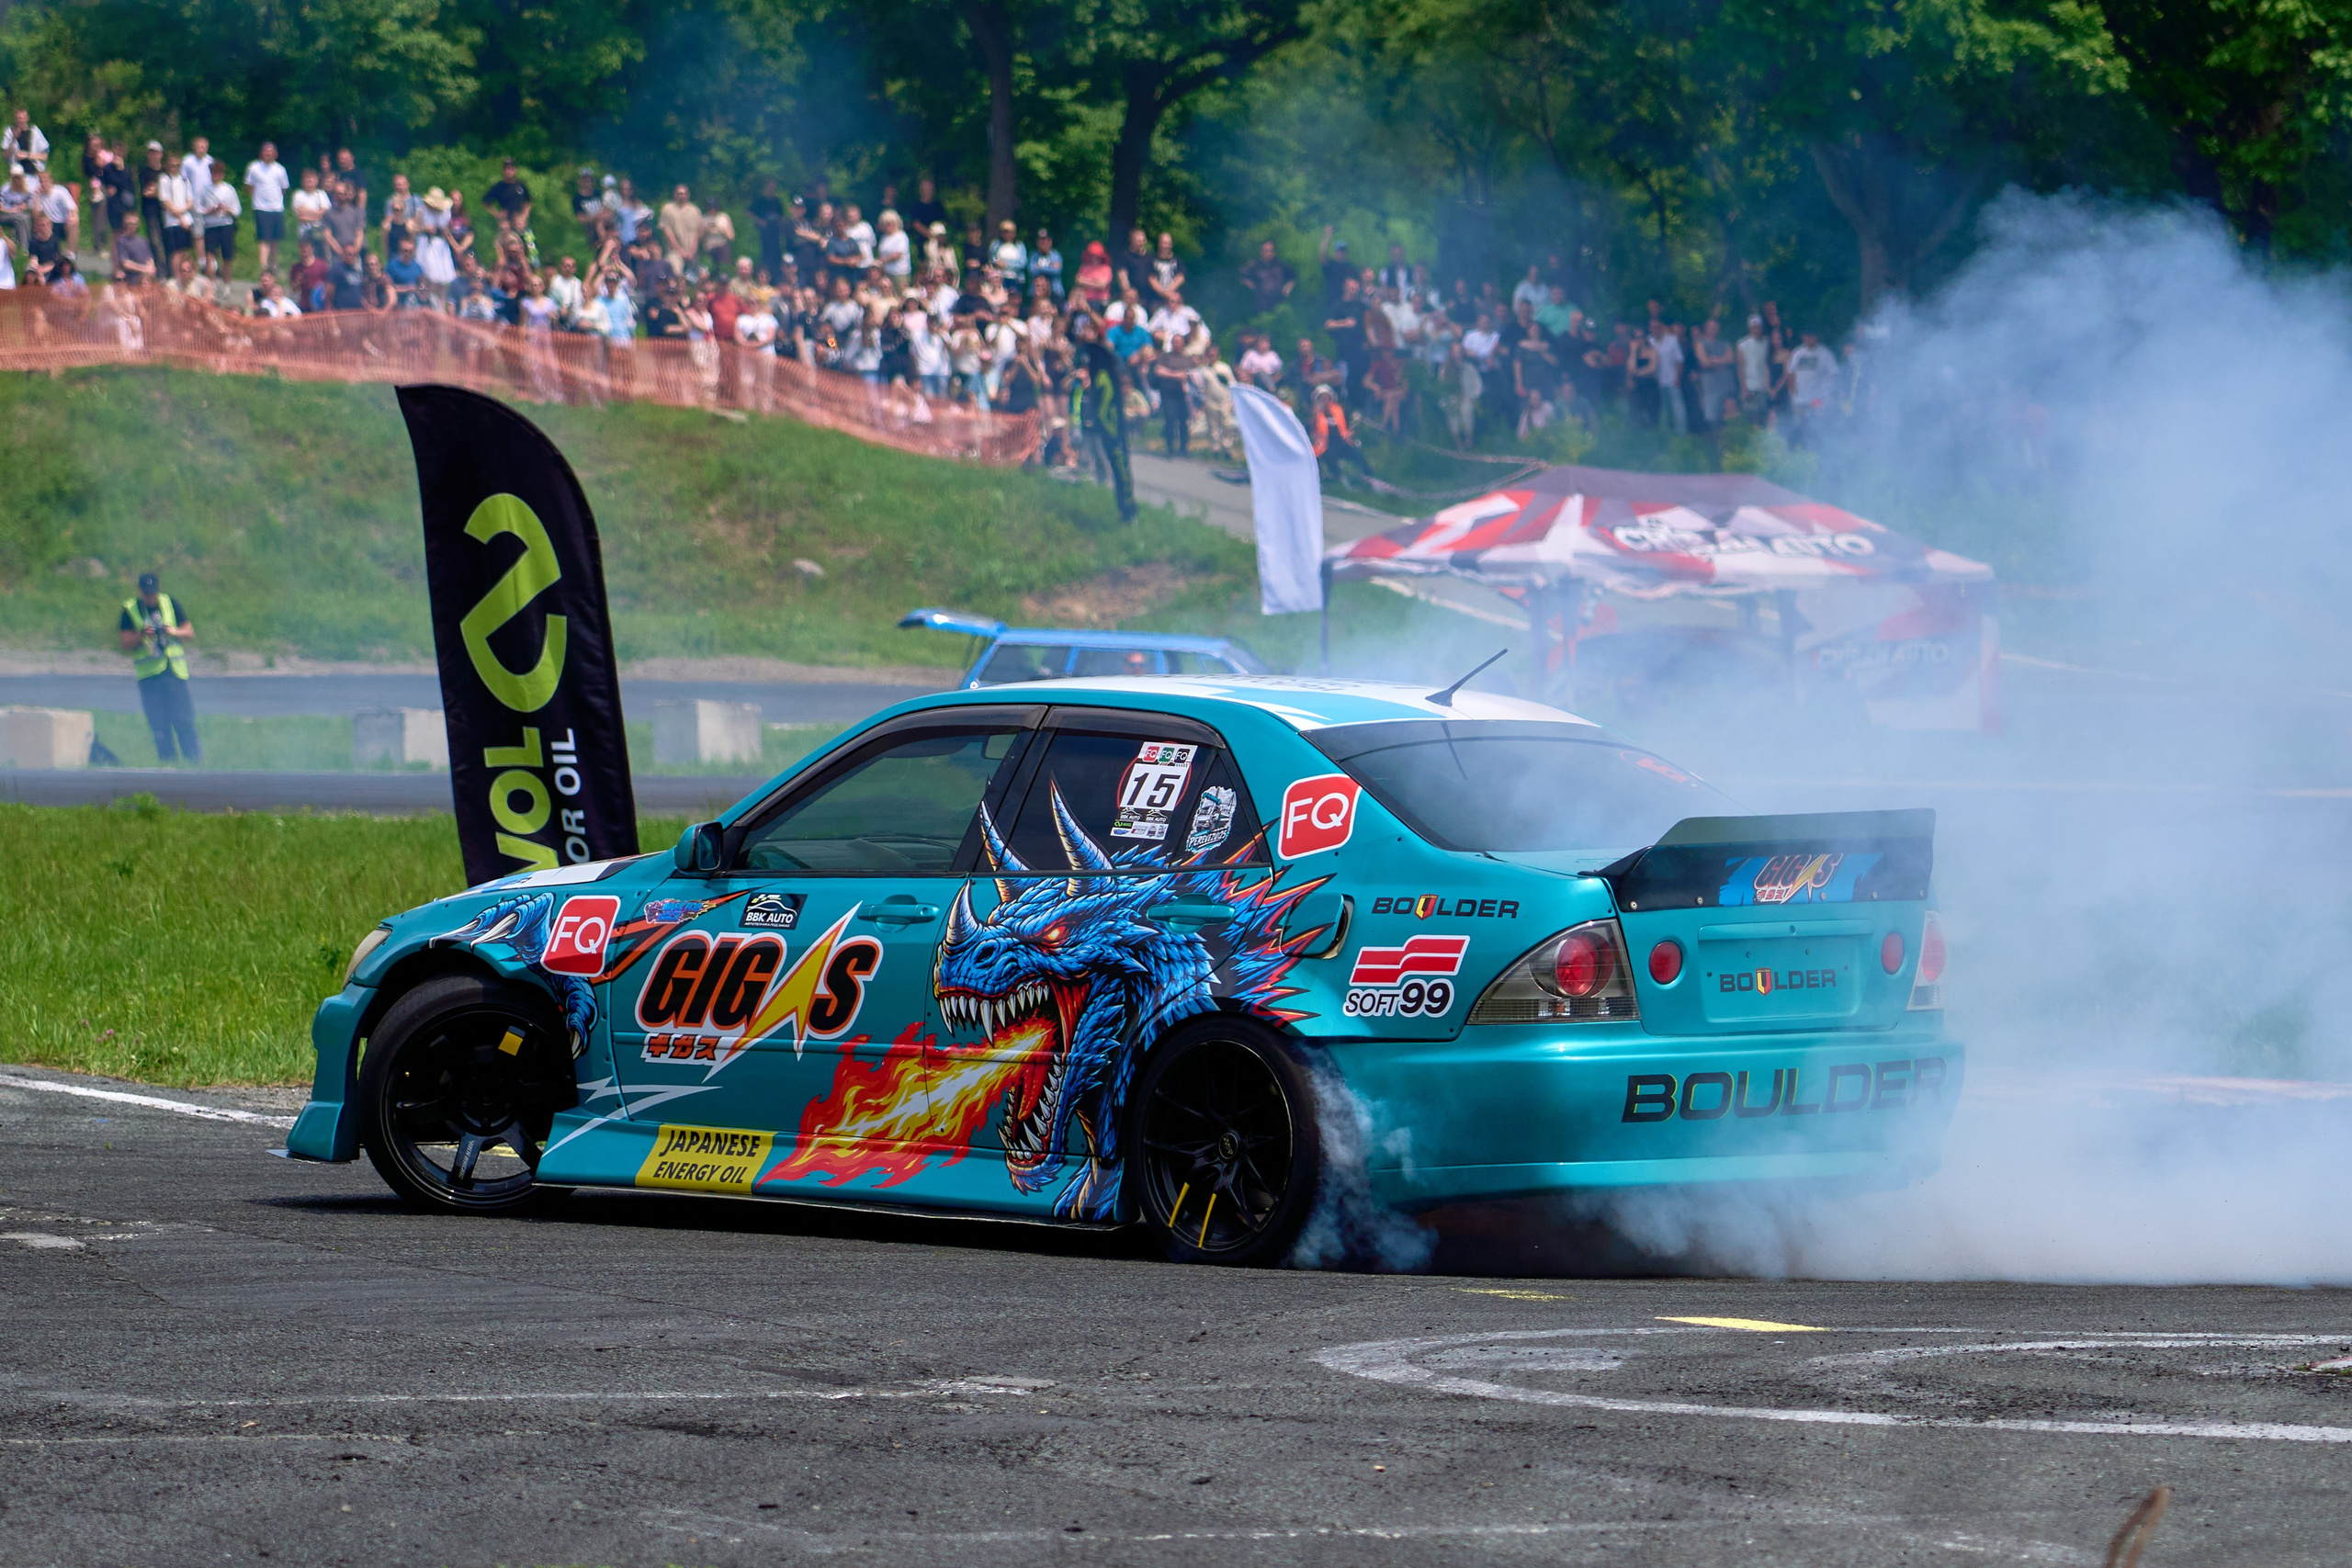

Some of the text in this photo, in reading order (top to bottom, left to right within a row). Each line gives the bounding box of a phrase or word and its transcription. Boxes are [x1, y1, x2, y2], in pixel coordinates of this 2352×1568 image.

[551, 728, 581, 796] OIL
[1126, 773, 1181, 808] 15
[1286, 793, 1350, 839] FQ
[745, 912, 794, 923] BBK AUTO
[1372, 895, 1520, 919] BOULDER
[550, 916, 607, 954] FQ
[638, 923, 882, 1047] GIGAS
[1345, 982, 1451, 1014] SOFT99
[1719, 968, 1837, 996] BOULDER
[647, 1033, 719, 1061] ギガス
[1621, 1057, 1948, 1122] BOULDER
[659, 1130, 761, 1157] JAPANESE
[653, 1161, 748, 1184] ENERGY OIL
